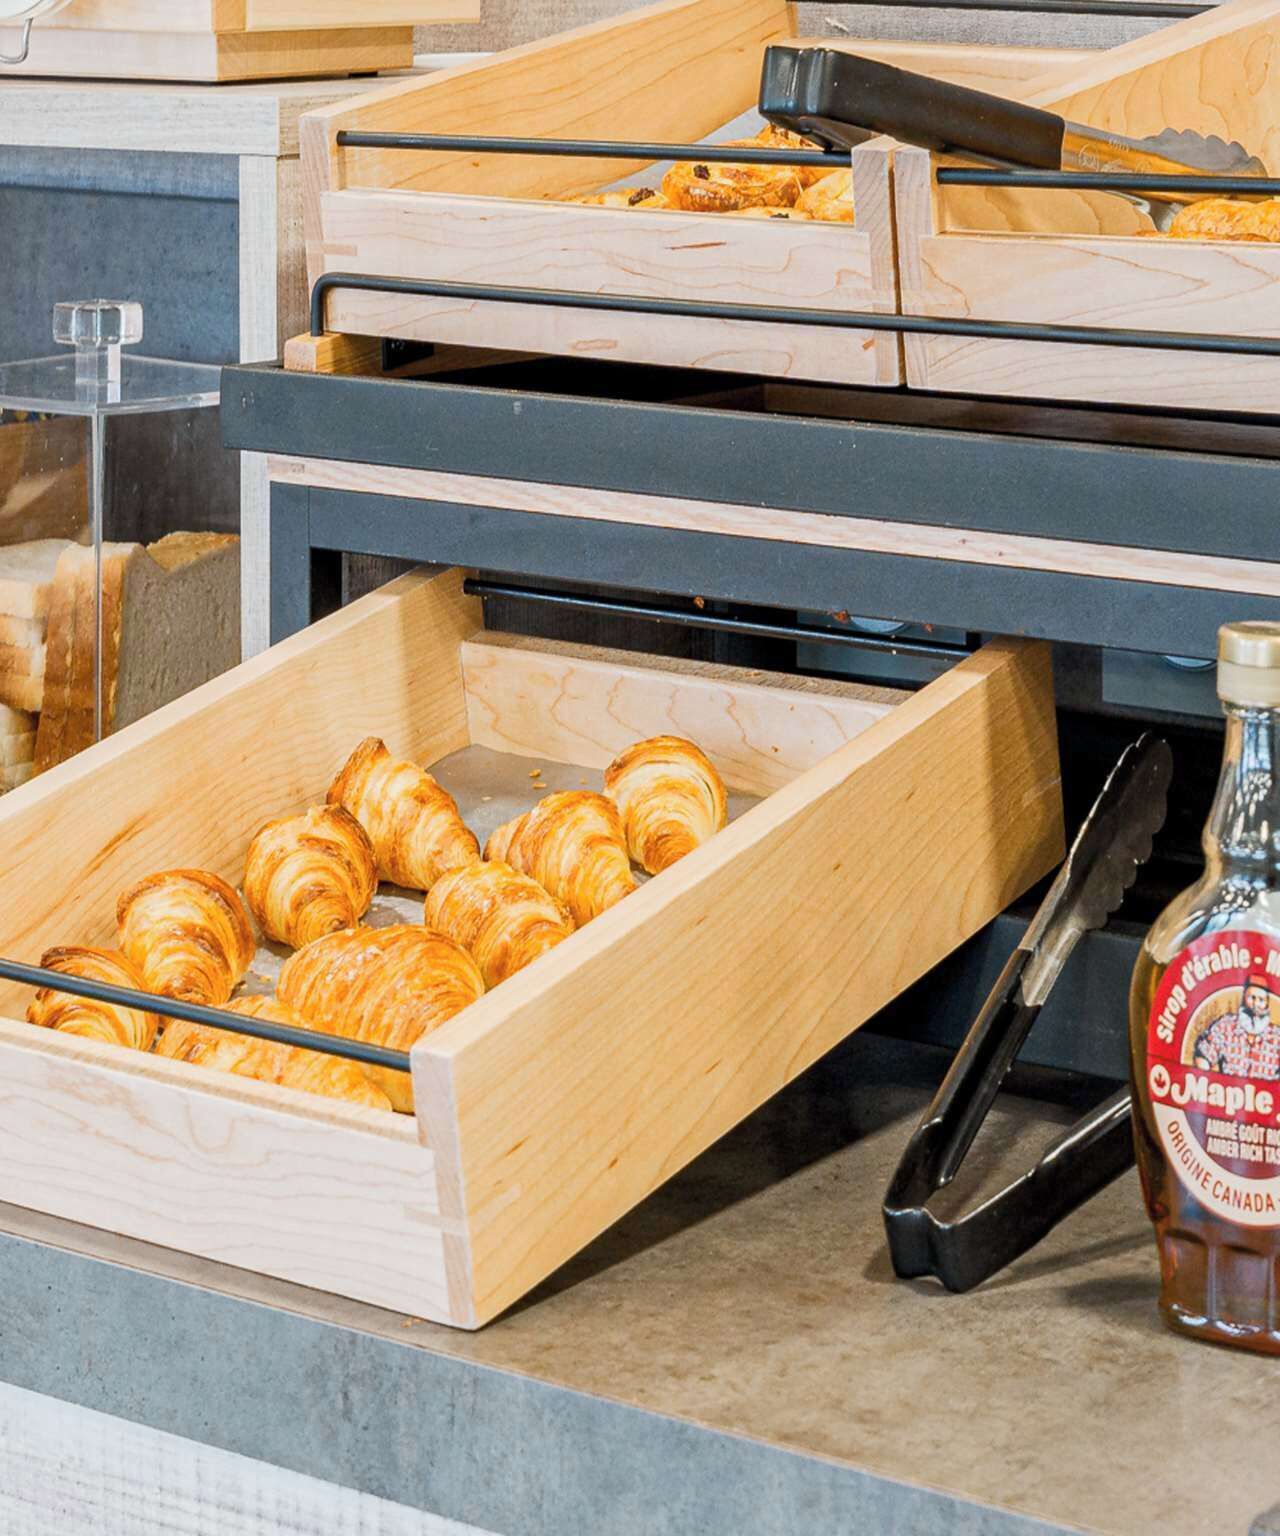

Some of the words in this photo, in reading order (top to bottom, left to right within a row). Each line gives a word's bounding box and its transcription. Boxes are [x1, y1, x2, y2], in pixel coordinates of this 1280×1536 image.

[1185, 943, 1251, 990] d'érable
[1171, 1072, 1274, 1115] Maple
[1167, 1119, 1212, 1191] ORIGINE
[1211, 1179, 1276, 1214] CANADA
